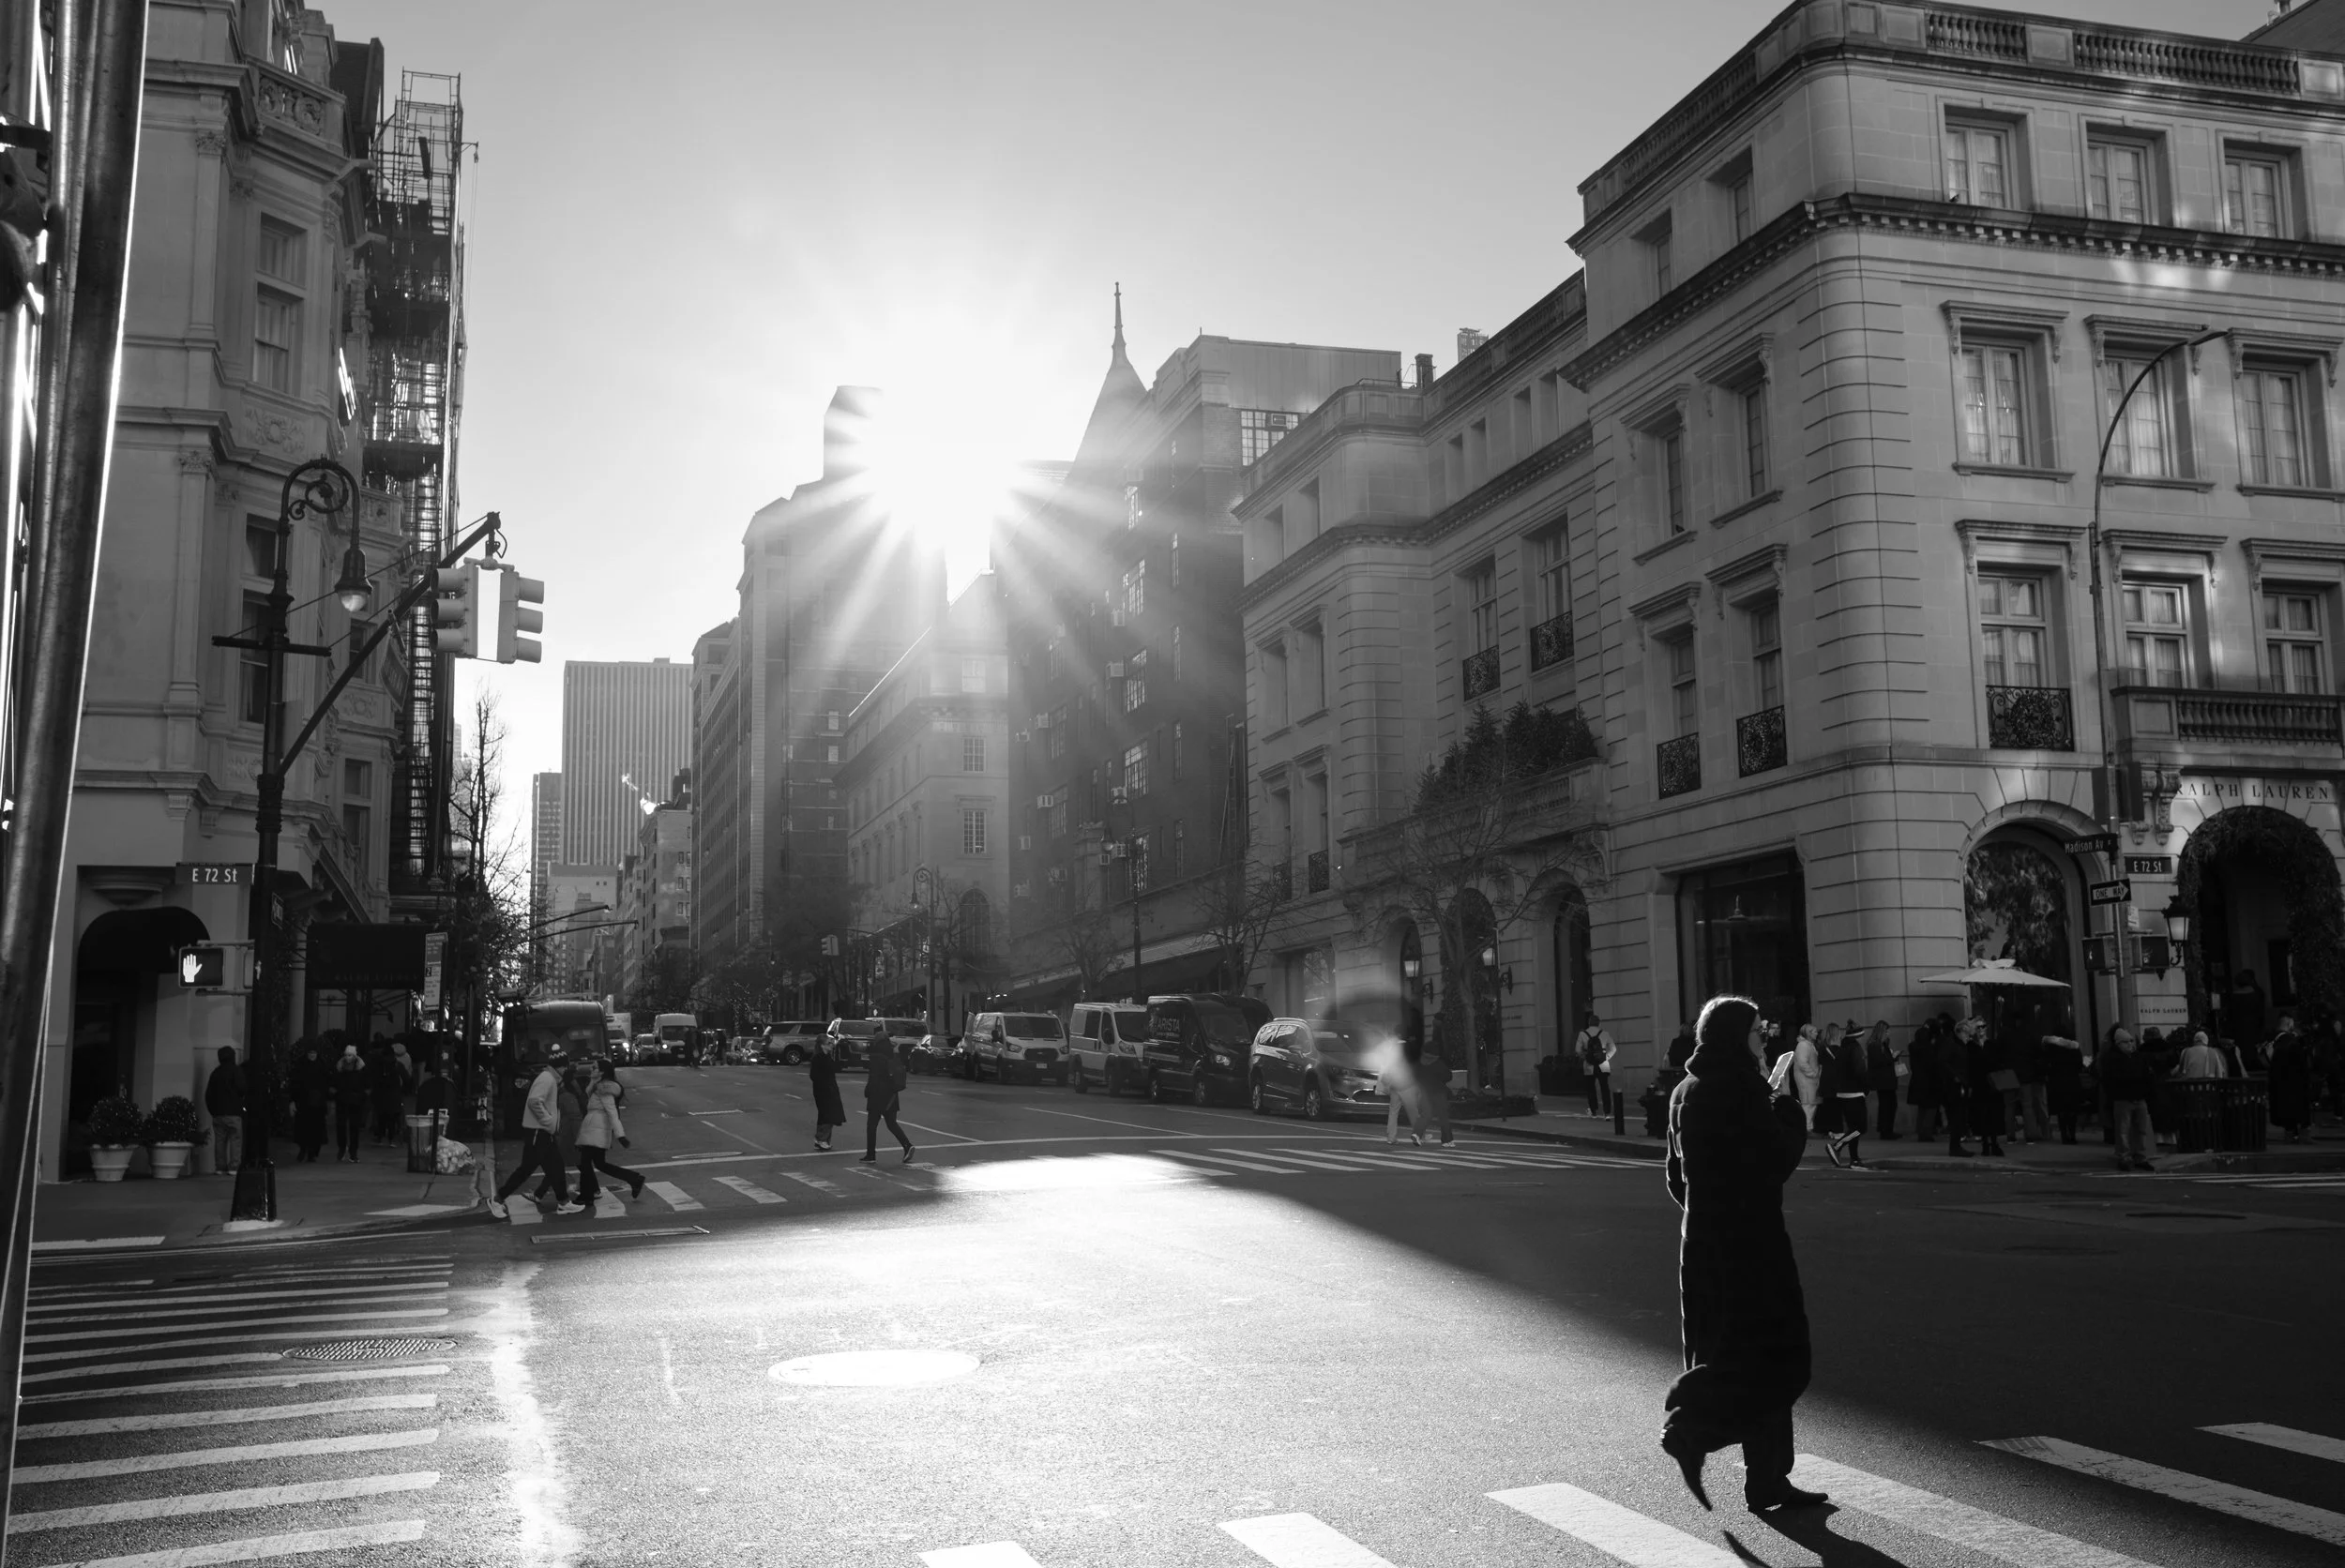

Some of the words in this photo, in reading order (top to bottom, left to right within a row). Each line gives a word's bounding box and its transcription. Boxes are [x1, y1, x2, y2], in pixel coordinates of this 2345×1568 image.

[2251, 785, 2328, 799] LAUREN
[2065, 840, 2093, 853] Madison
[2095, 839, 2104, 850] Av
[2133, 861, 2139, 872] E
[2141, 861, 2150, 872] 72
[2153, 861, 2162, 872] St
[192, 868, 199, 882] E
[204, 868, 218, 882] 72
[224, 868, 237, 882] St
[2095, 888, 2109, 899] ONE
